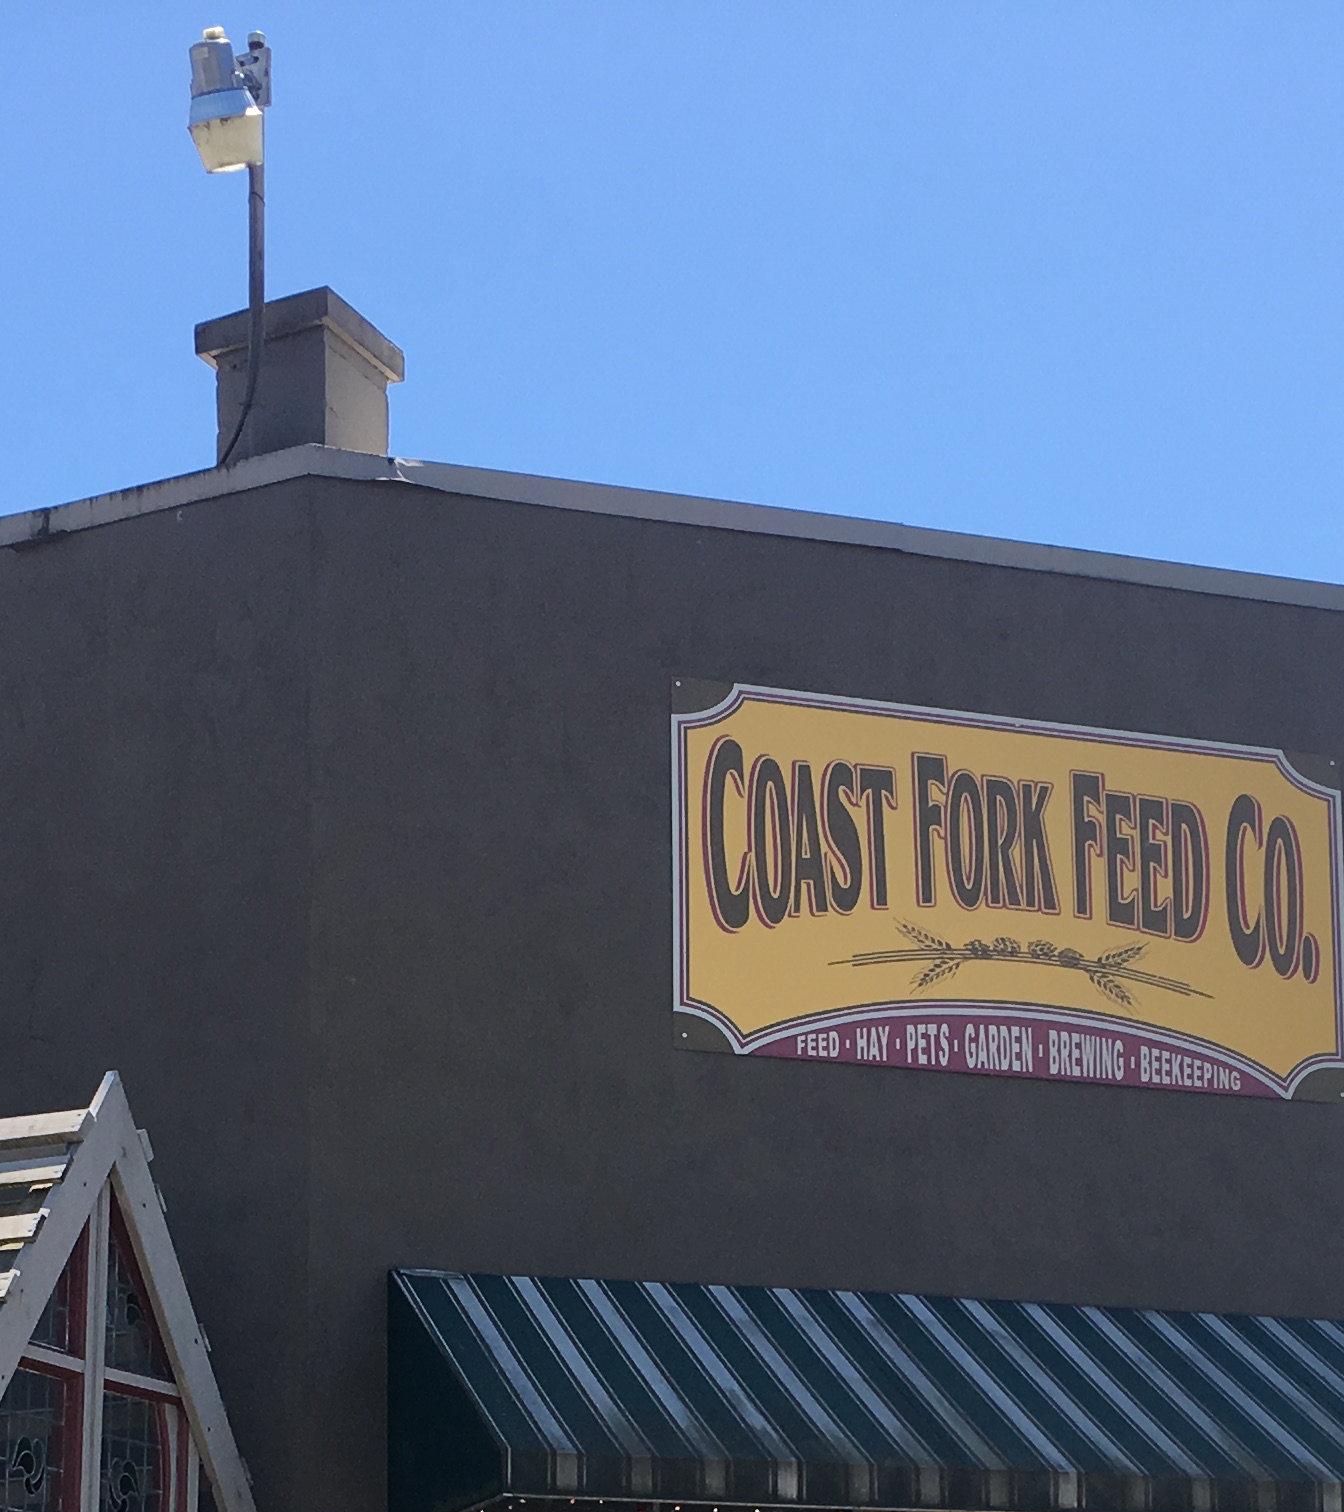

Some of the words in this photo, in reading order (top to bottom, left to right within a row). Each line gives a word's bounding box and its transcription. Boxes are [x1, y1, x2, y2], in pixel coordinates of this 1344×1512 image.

[702, 735, 897, 932] COAST
[911, 751, 1060, 914] FORK
[1070, 770, 1209, 942] FEED
[1225, 794, 1319, 985] CO.
[797, 1031, 839, 1057] FEED
[856, 1026, 889, 1062] HAY
[906, 1023, 949, 1066] PETS
[964, 1024, 1033, 1073] GARDEN
[1048, 1029, 1124, 1081] BREWING
[1139, 1046, 1241, 1091] BEEKEEPING
